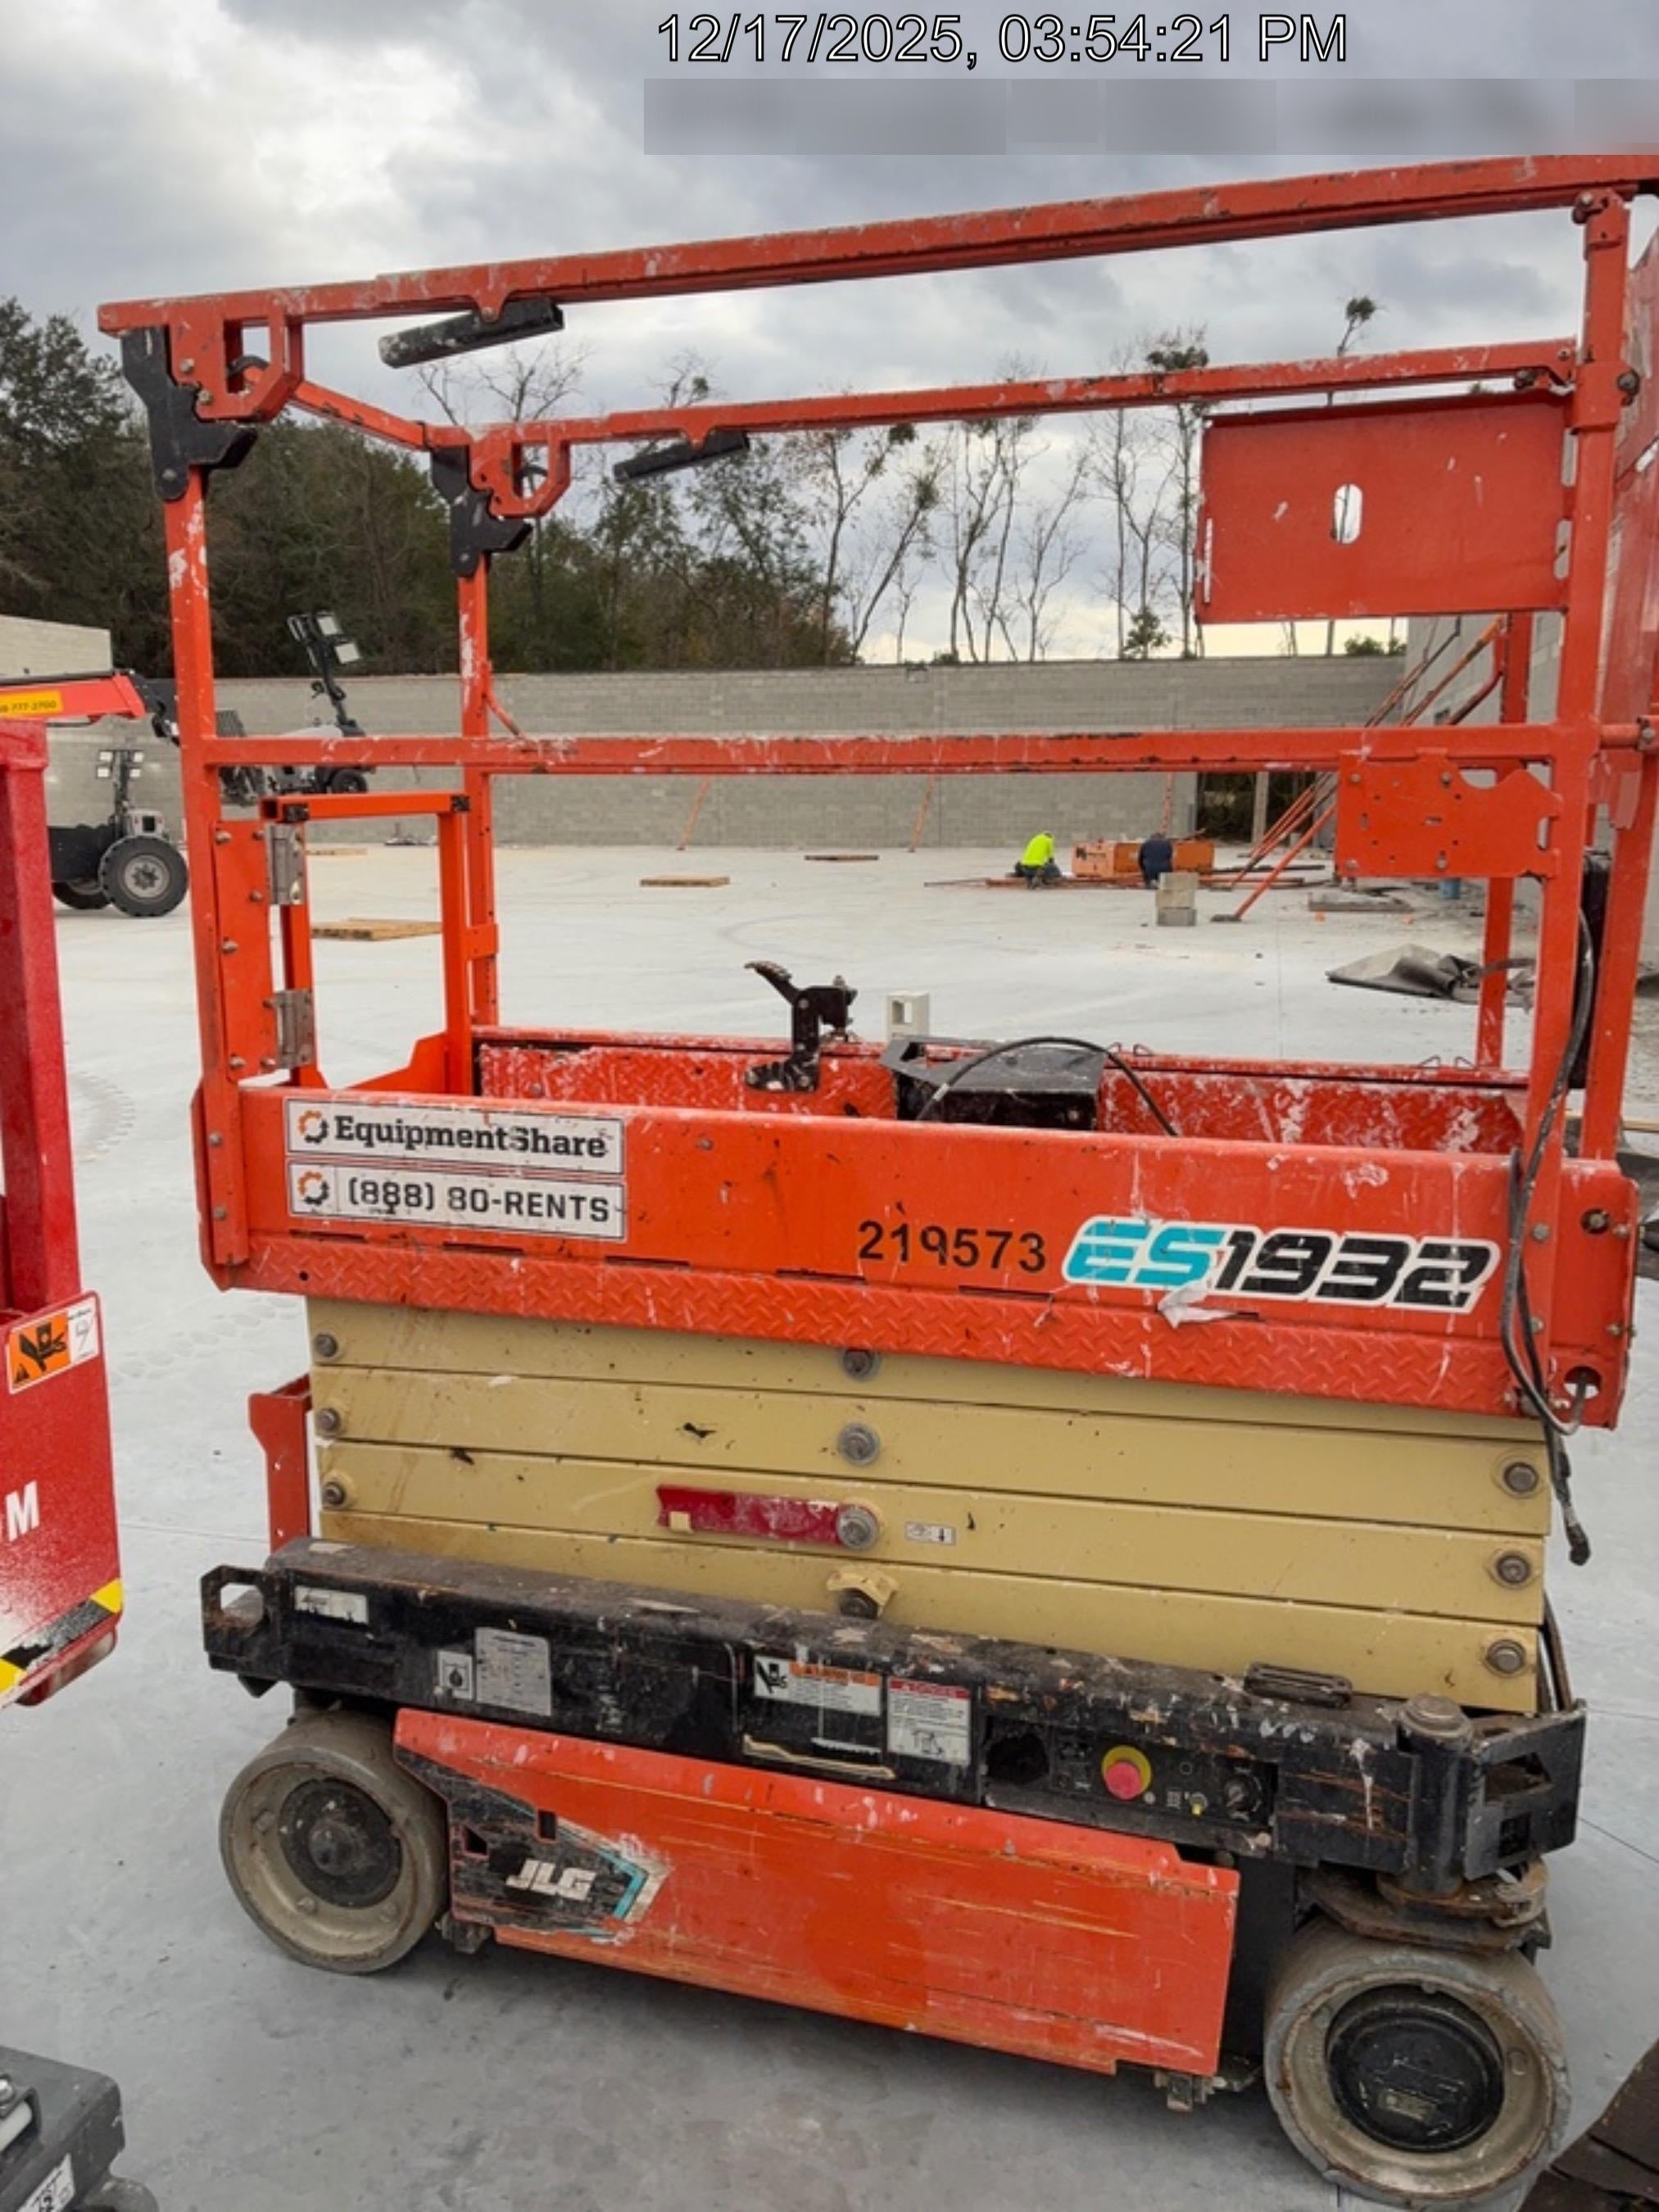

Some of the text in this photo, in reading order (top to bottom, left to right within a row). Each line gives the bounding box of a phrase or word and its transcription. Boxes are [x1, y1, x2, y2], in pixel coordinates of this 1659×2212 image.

[333, 1114, 606, 1159] EquipmentShare
[349, 1176, 610, 1223] (888) 80-RENTS
[857, 1220, 1046, 1272] 219573
[1065, 1218, 1492, 1311] ES1932
[505, 1859, 597, 1902] JLG
